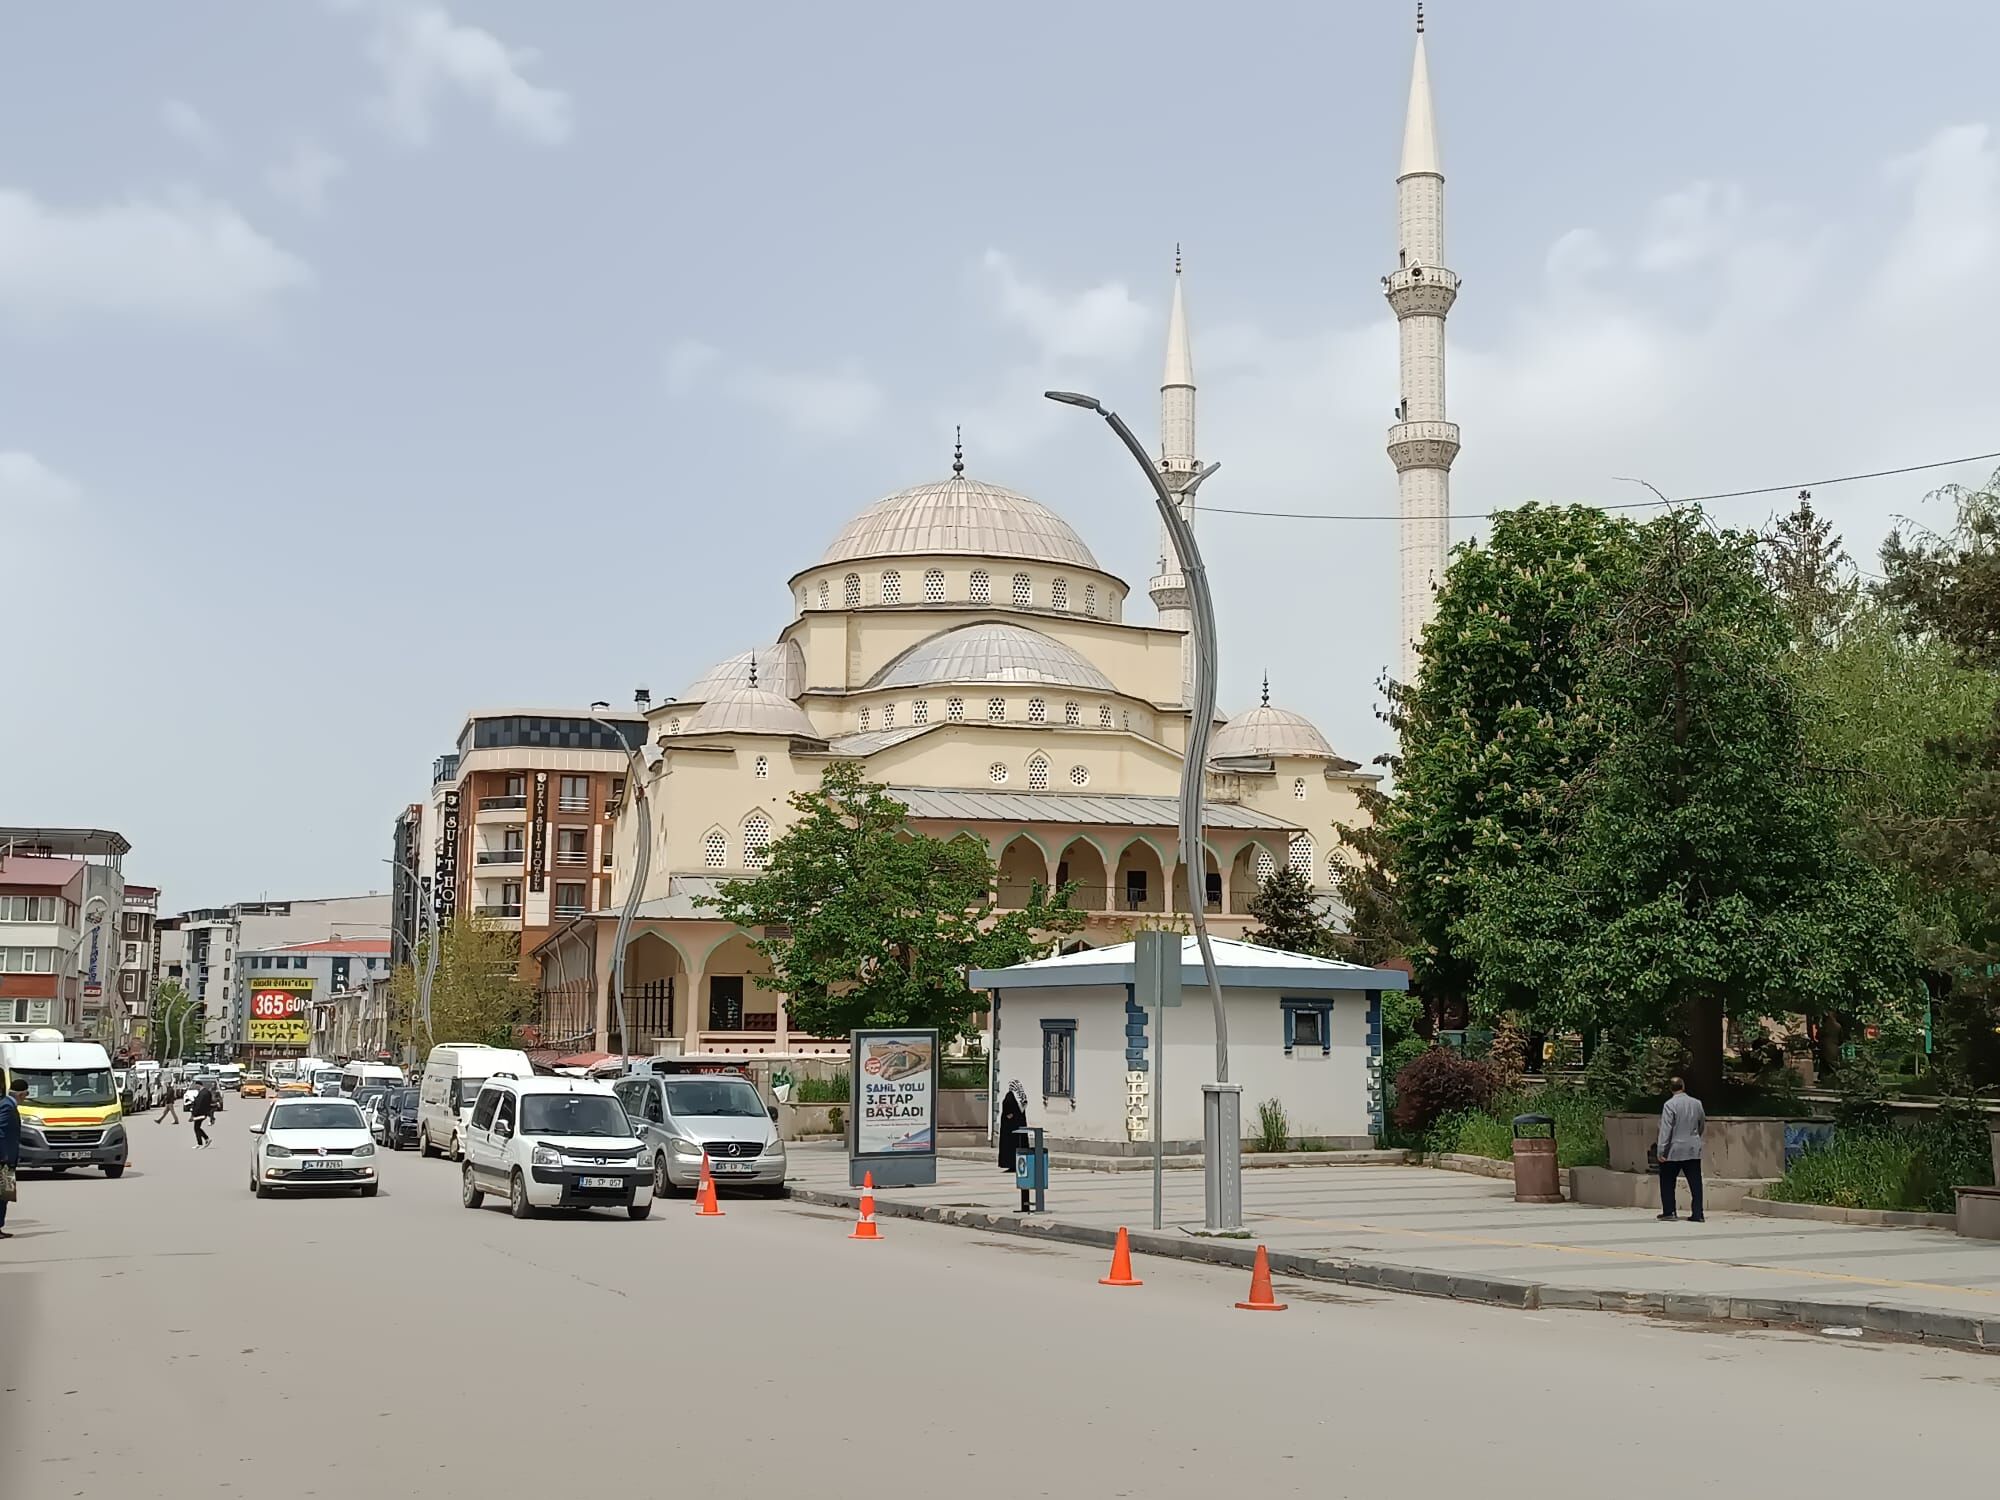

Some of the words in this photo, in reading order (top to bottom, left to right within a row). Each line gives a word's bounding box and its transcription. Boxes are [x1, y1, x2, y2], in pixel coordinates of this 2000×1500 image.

[256, 994, 284, 1015] 365
[866, 1083, 896, 1093] SAHİL
[898, 1082, 925, 1092] YOLU
[866, 1094, 914, 1105] 3.ETAP
[866, 1106, 924, 1119] BAŞLADI
